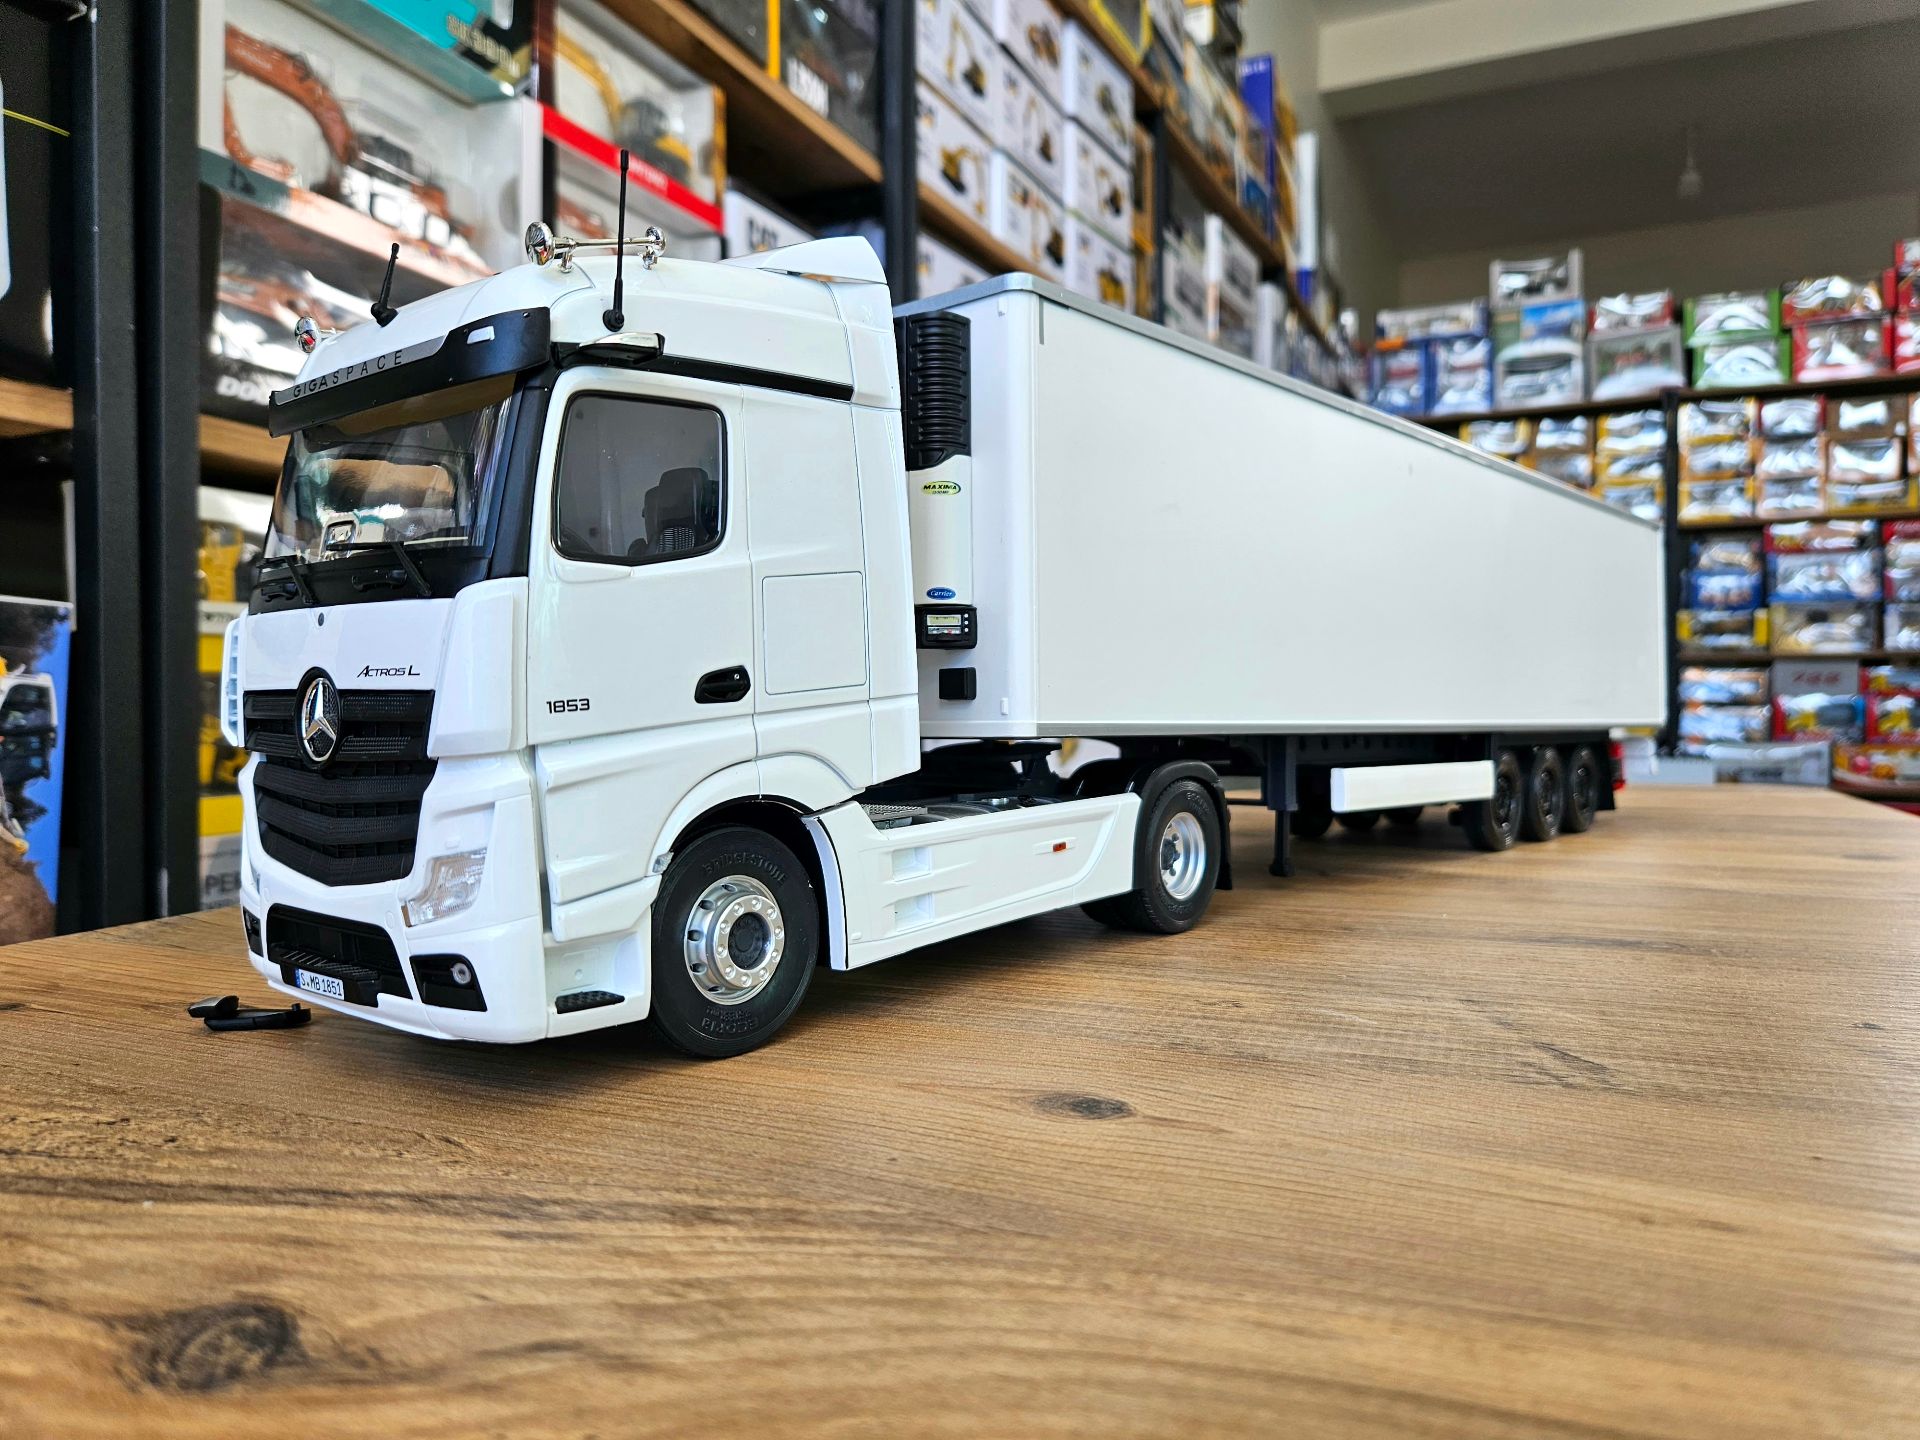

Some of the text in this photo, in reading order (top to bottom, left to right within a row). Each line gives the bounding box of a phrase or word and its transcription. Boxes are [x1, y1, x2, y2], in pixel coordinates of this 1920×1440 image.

[293, 350, 402, 398] GIGASPACE
[408, 665, 420, 676] L
[546, 698, 590, 714] 1853
[321, 978, 343, 997] 1851
